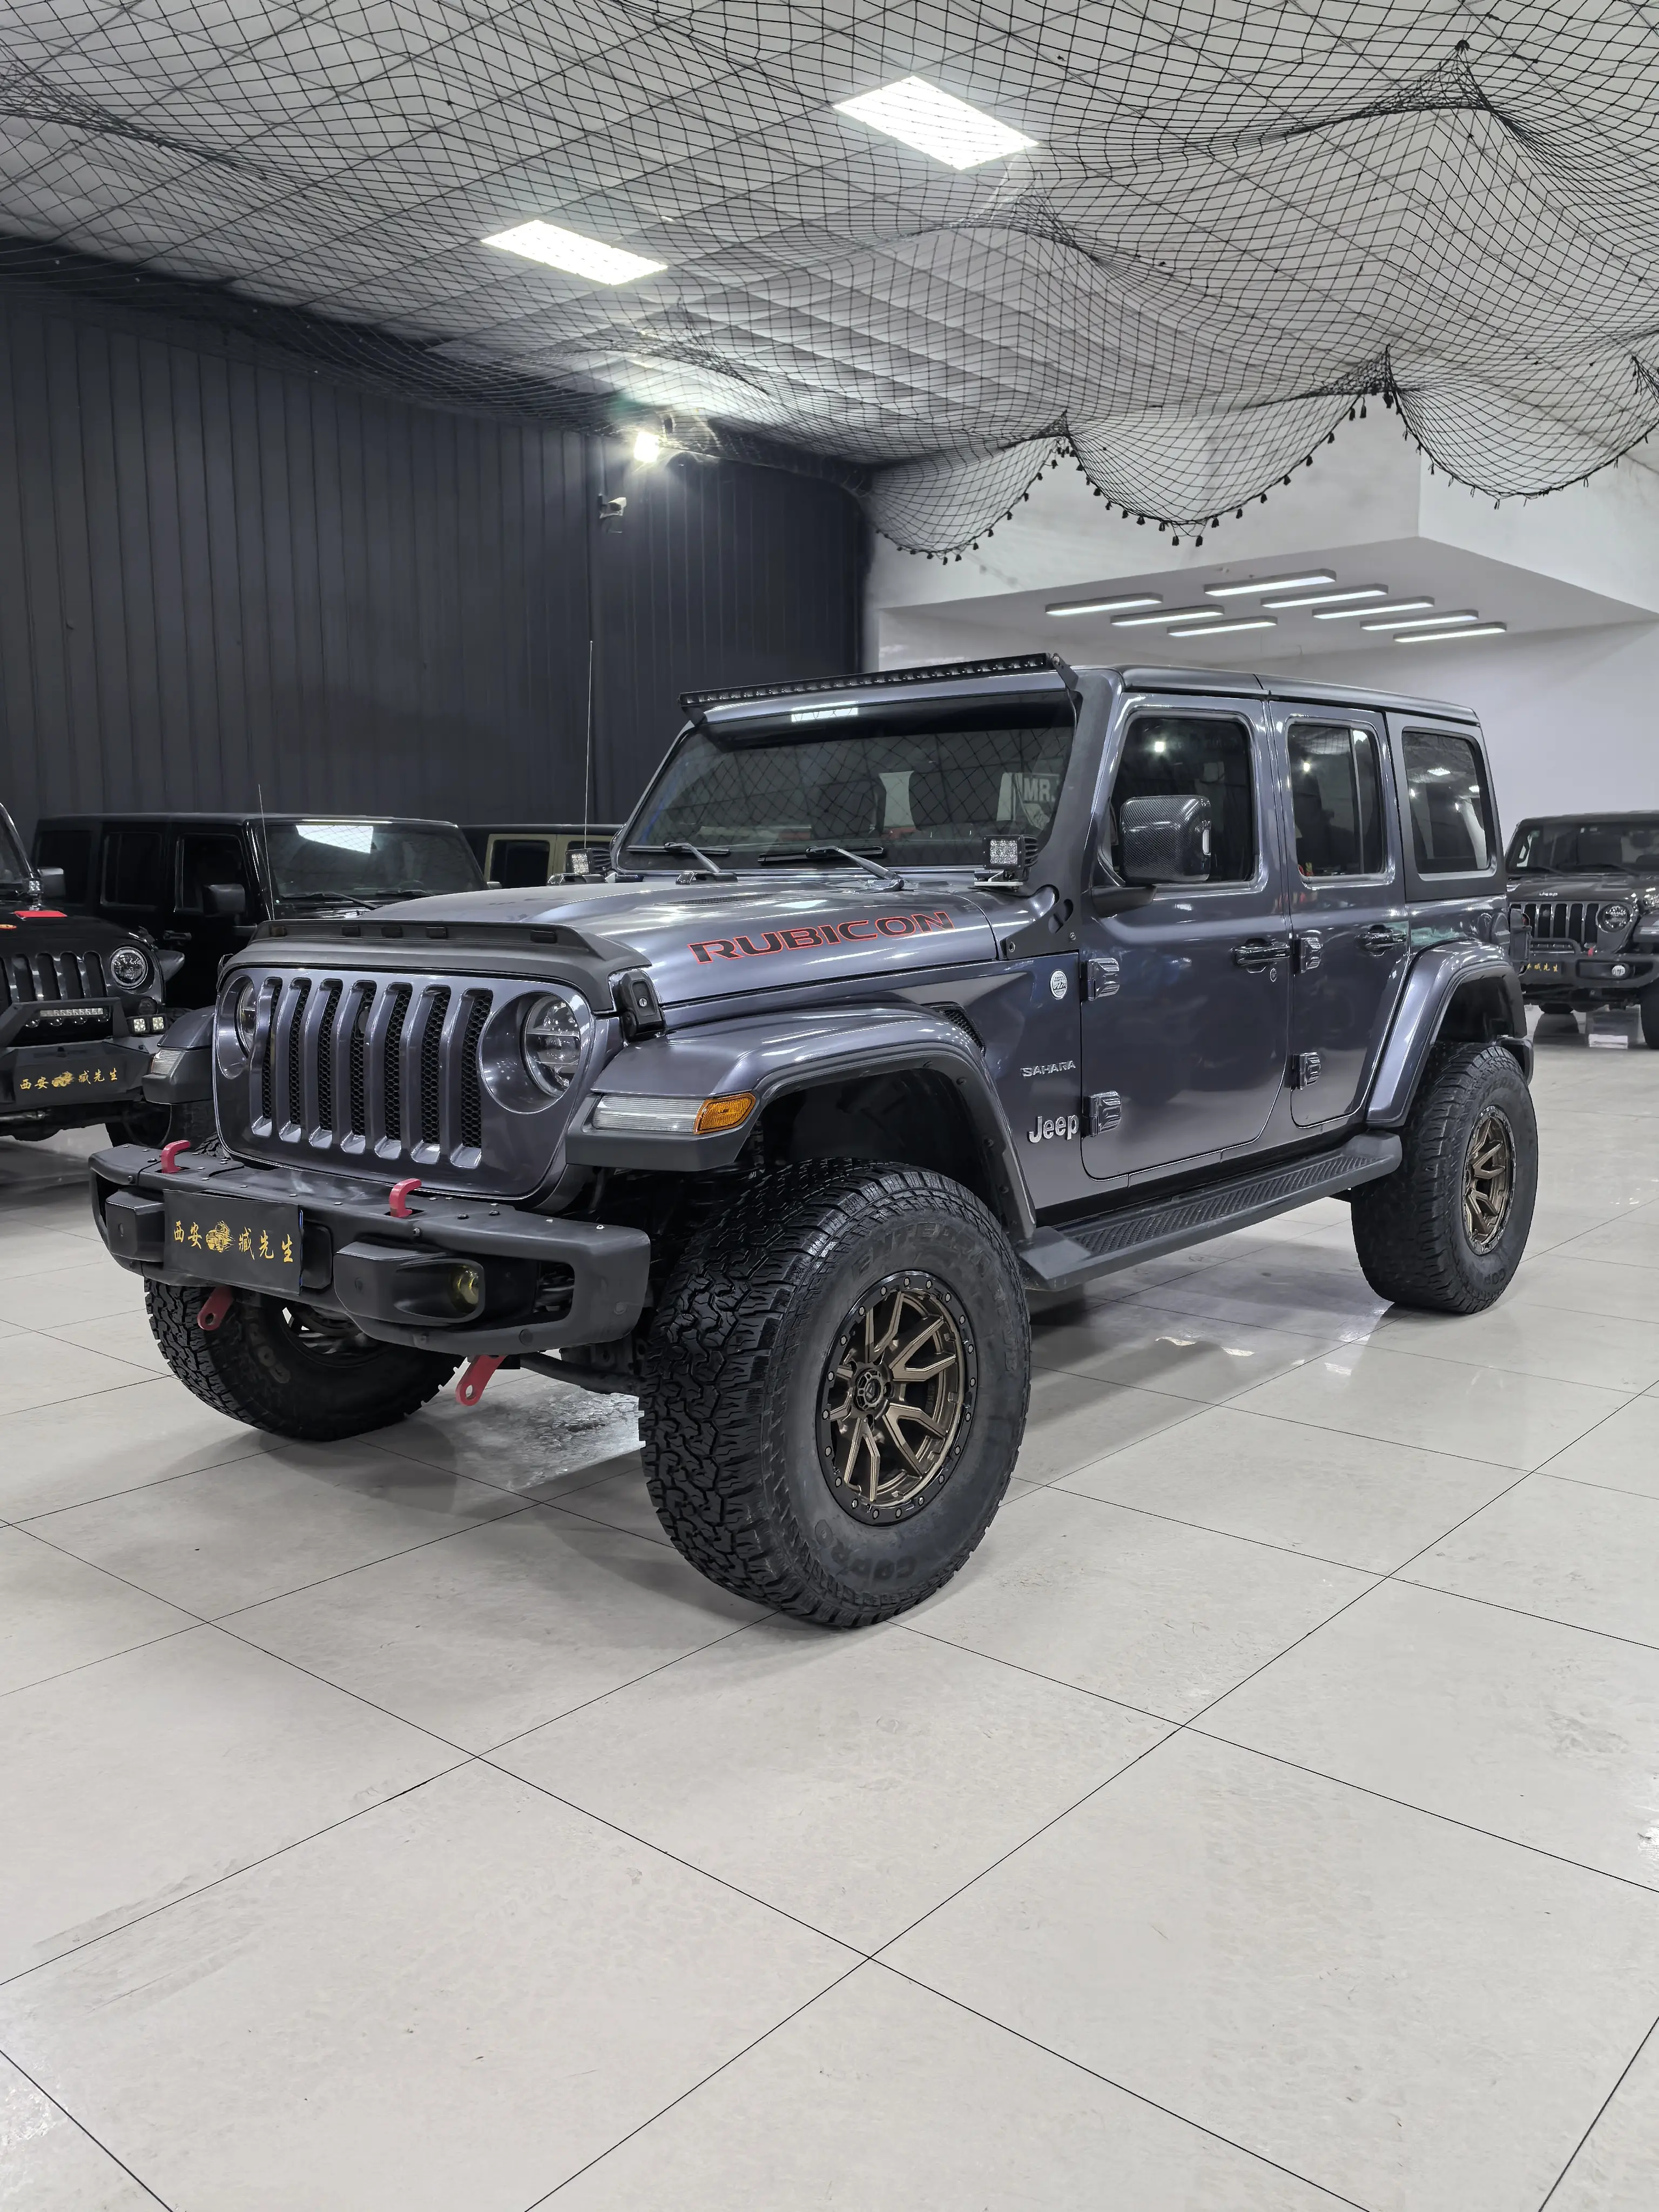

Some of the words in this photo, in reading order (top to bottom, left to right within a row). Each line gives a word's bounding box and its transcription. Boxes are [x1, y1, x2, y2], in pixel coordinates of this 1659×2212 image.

[687, 911, 956, 964] RUBICON
[19, 1076, 49, 1090] 西安
[1020, 1060, 1076, 1078] SAHARA
[1028, 1114, 1080, 1144] Jeep
[173, 1220, 203, 1250] 西安
